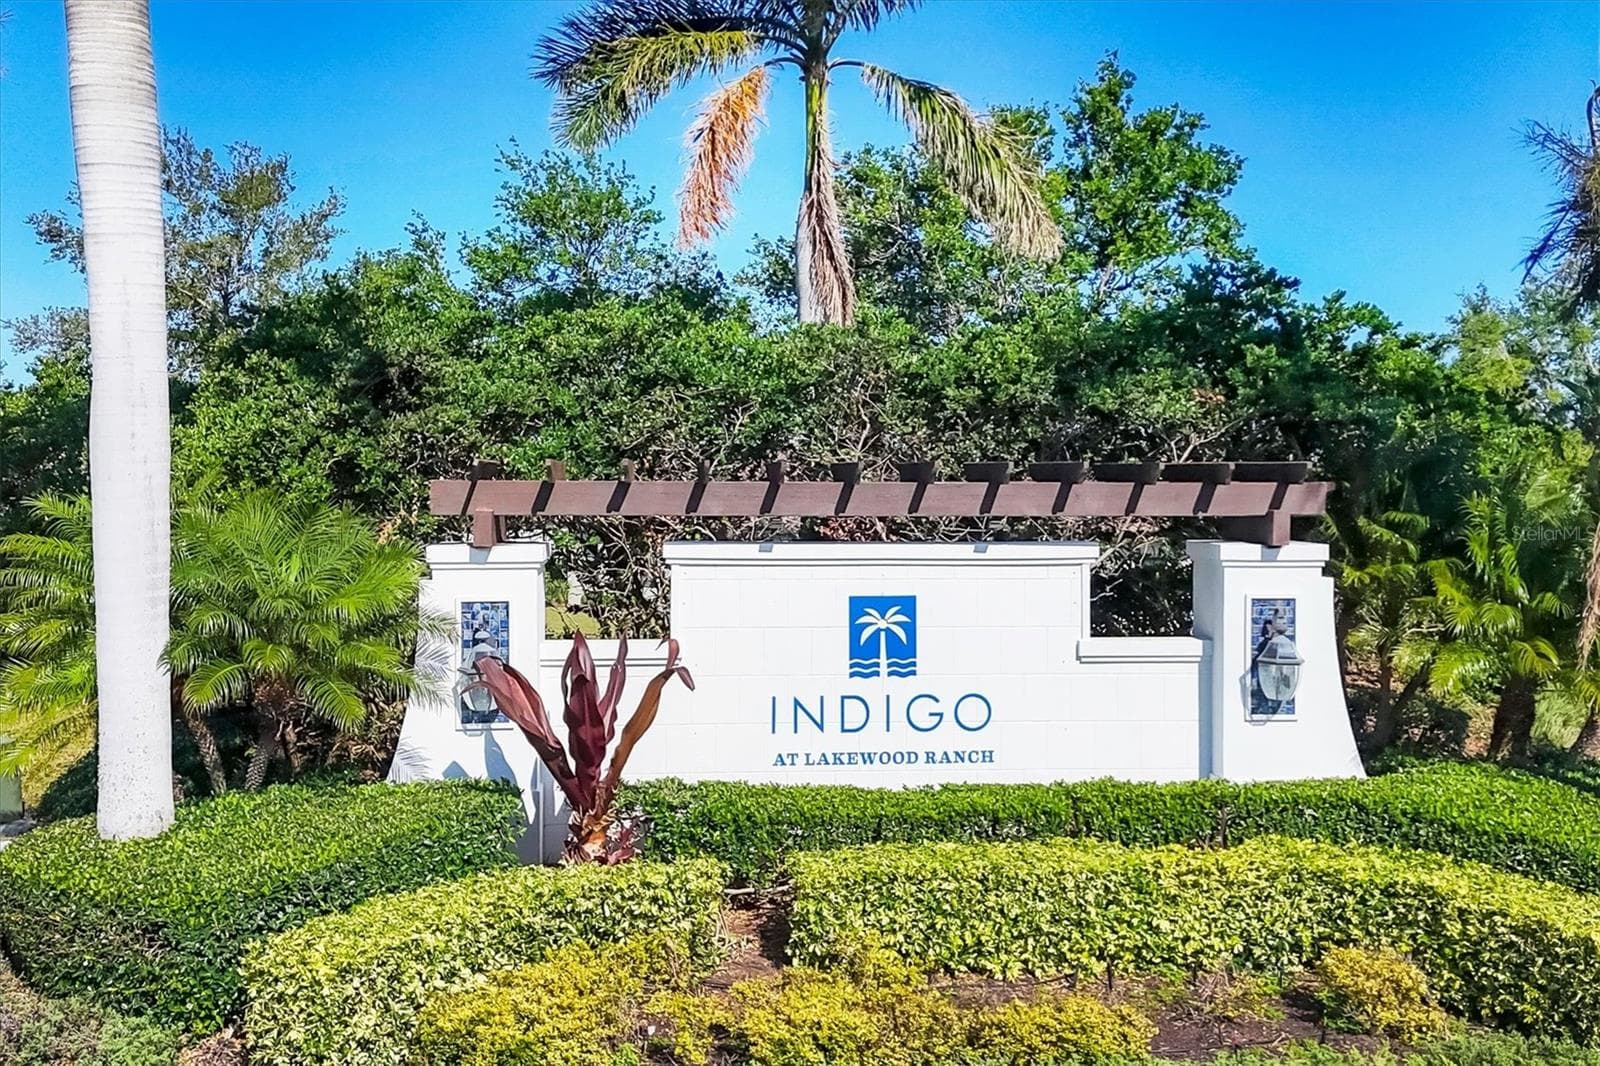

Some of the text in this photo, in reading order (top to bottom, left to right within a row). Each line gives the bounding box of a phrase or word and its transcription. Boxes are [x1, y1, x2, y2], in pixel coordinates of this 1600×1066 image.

[771, 693, 992, 734] INDIGO
[772, 750, 995, 766] AT LAKEWOOD RANCH
